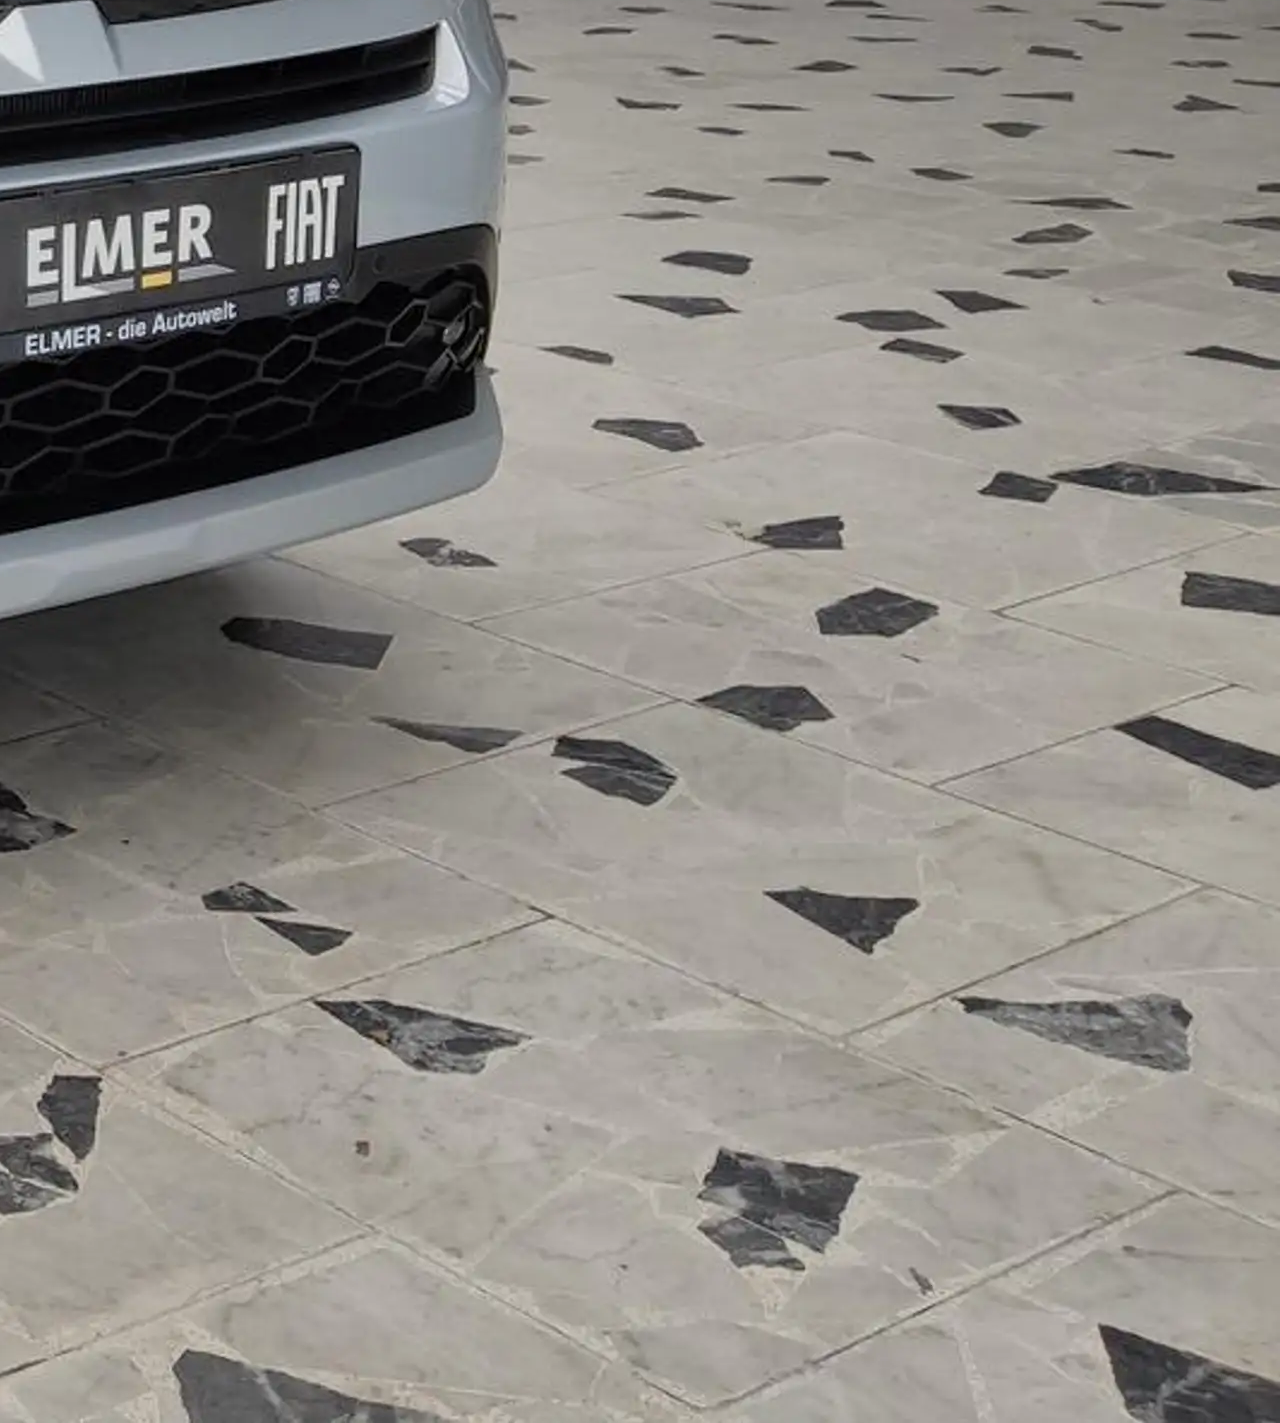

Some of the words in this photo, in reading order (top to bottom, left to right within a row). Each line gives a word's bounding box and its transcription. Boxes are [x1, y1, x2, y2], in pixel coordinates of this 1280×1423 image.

[27, 203, 213, 302] ELMER
[265, 174, 345, 270] FIAT
[25, 327, 101, 356] ELMER
[118, 316, 147, 340] die
[152, 301, 238, 335] Autowelt
